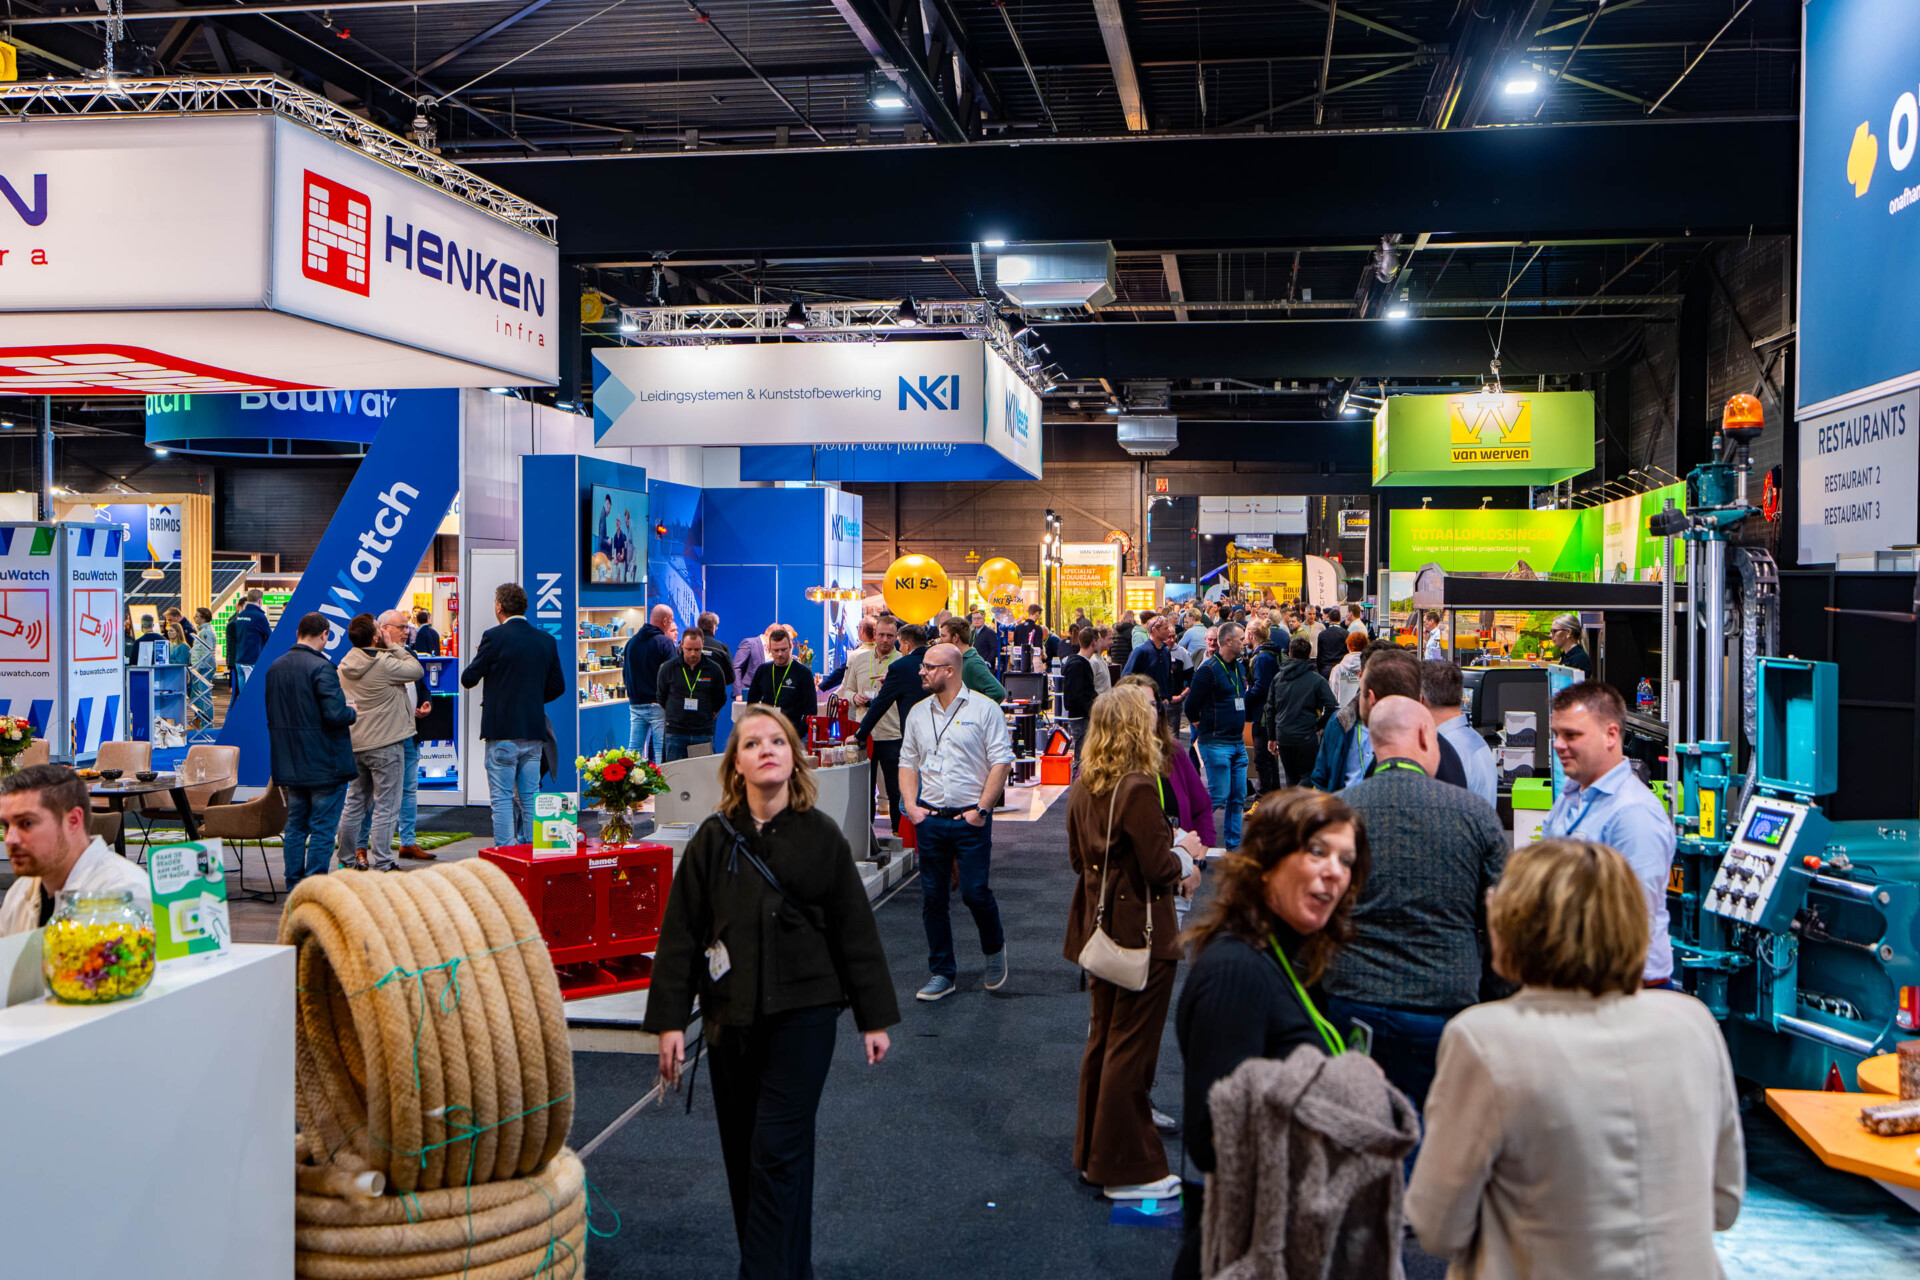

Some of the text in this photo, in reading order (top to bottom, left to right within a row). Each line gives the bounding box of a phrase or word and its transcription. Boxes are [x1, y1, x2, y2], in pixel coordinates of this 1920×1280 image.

[496, 314, 545, 347] infra
[640, 386, 882, 404] Leidingsystemen & Kunststofbewerking
[898, 375, 960, 411] NKI
[1818, 403, 1906, 455] RESTAURANTS
[1453, 449, 1529, 460] van werven
[1824, 466, 1881, 494] RESTAURANT 2
[1824, 501, 1881, 526] RESTAURANT 3
[150, 518, 181, 532] BRIMOS
[1411, 528, 1554, 540] TOTAALOPLOSSINGEN
[73, 569, 118, 581] BauWatch
[896, 577, 914, 590] NKI
[537, 572, 562, 618] NKI
[80, 667, 119, 677] bauwatch.com
